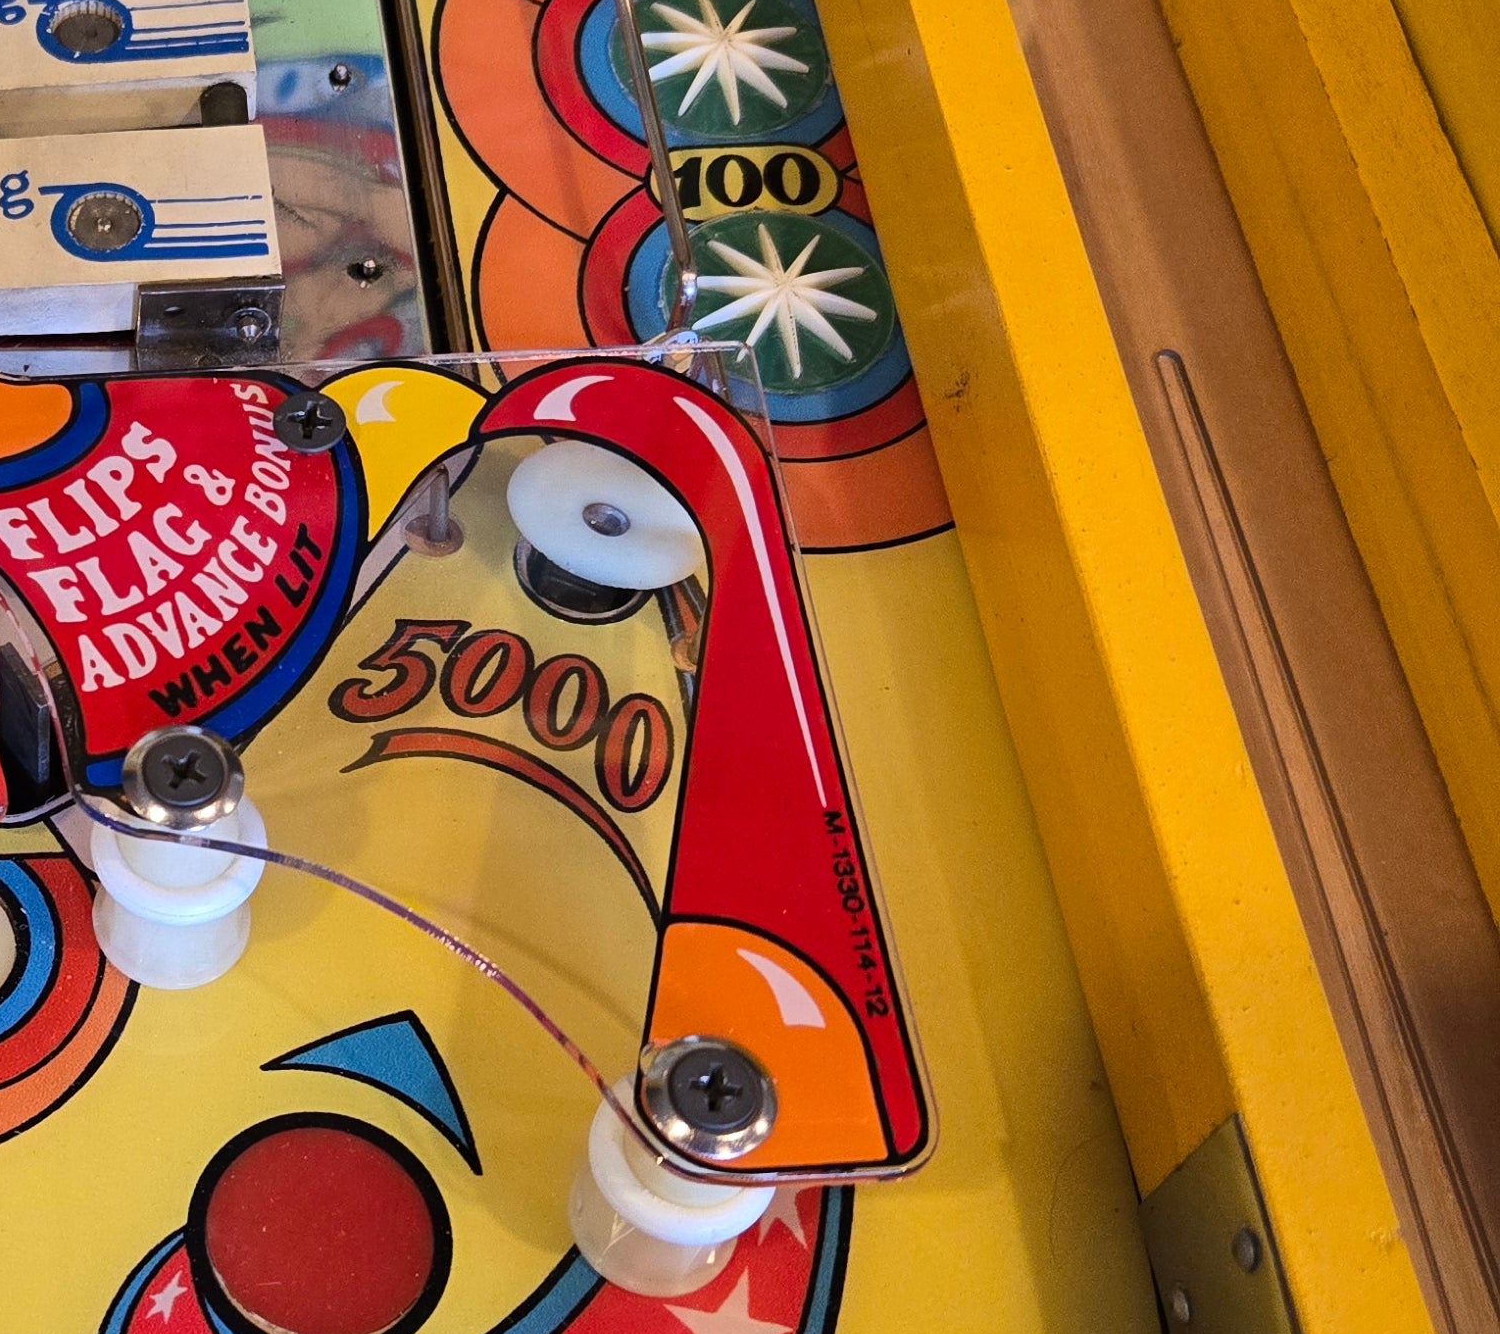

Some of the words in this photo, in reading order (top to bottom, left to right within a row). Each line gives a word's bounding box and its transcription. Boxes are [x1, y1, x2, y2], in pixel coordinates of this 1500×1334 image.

[672, 152, 821, 211] 100
[27, 501, 212, 623] FLAG
[183, 463, 236, 506] &
[79, 515, 278, 693] ADVANCE
[229, 382, 293, 526] BONUS
[148, 605, 283, 719] WHEN
[274, 522, 323, 609] LIT
[327, 618, 675, 814] 5000
[822, 809, 889, 1018] M-1330-114-12
